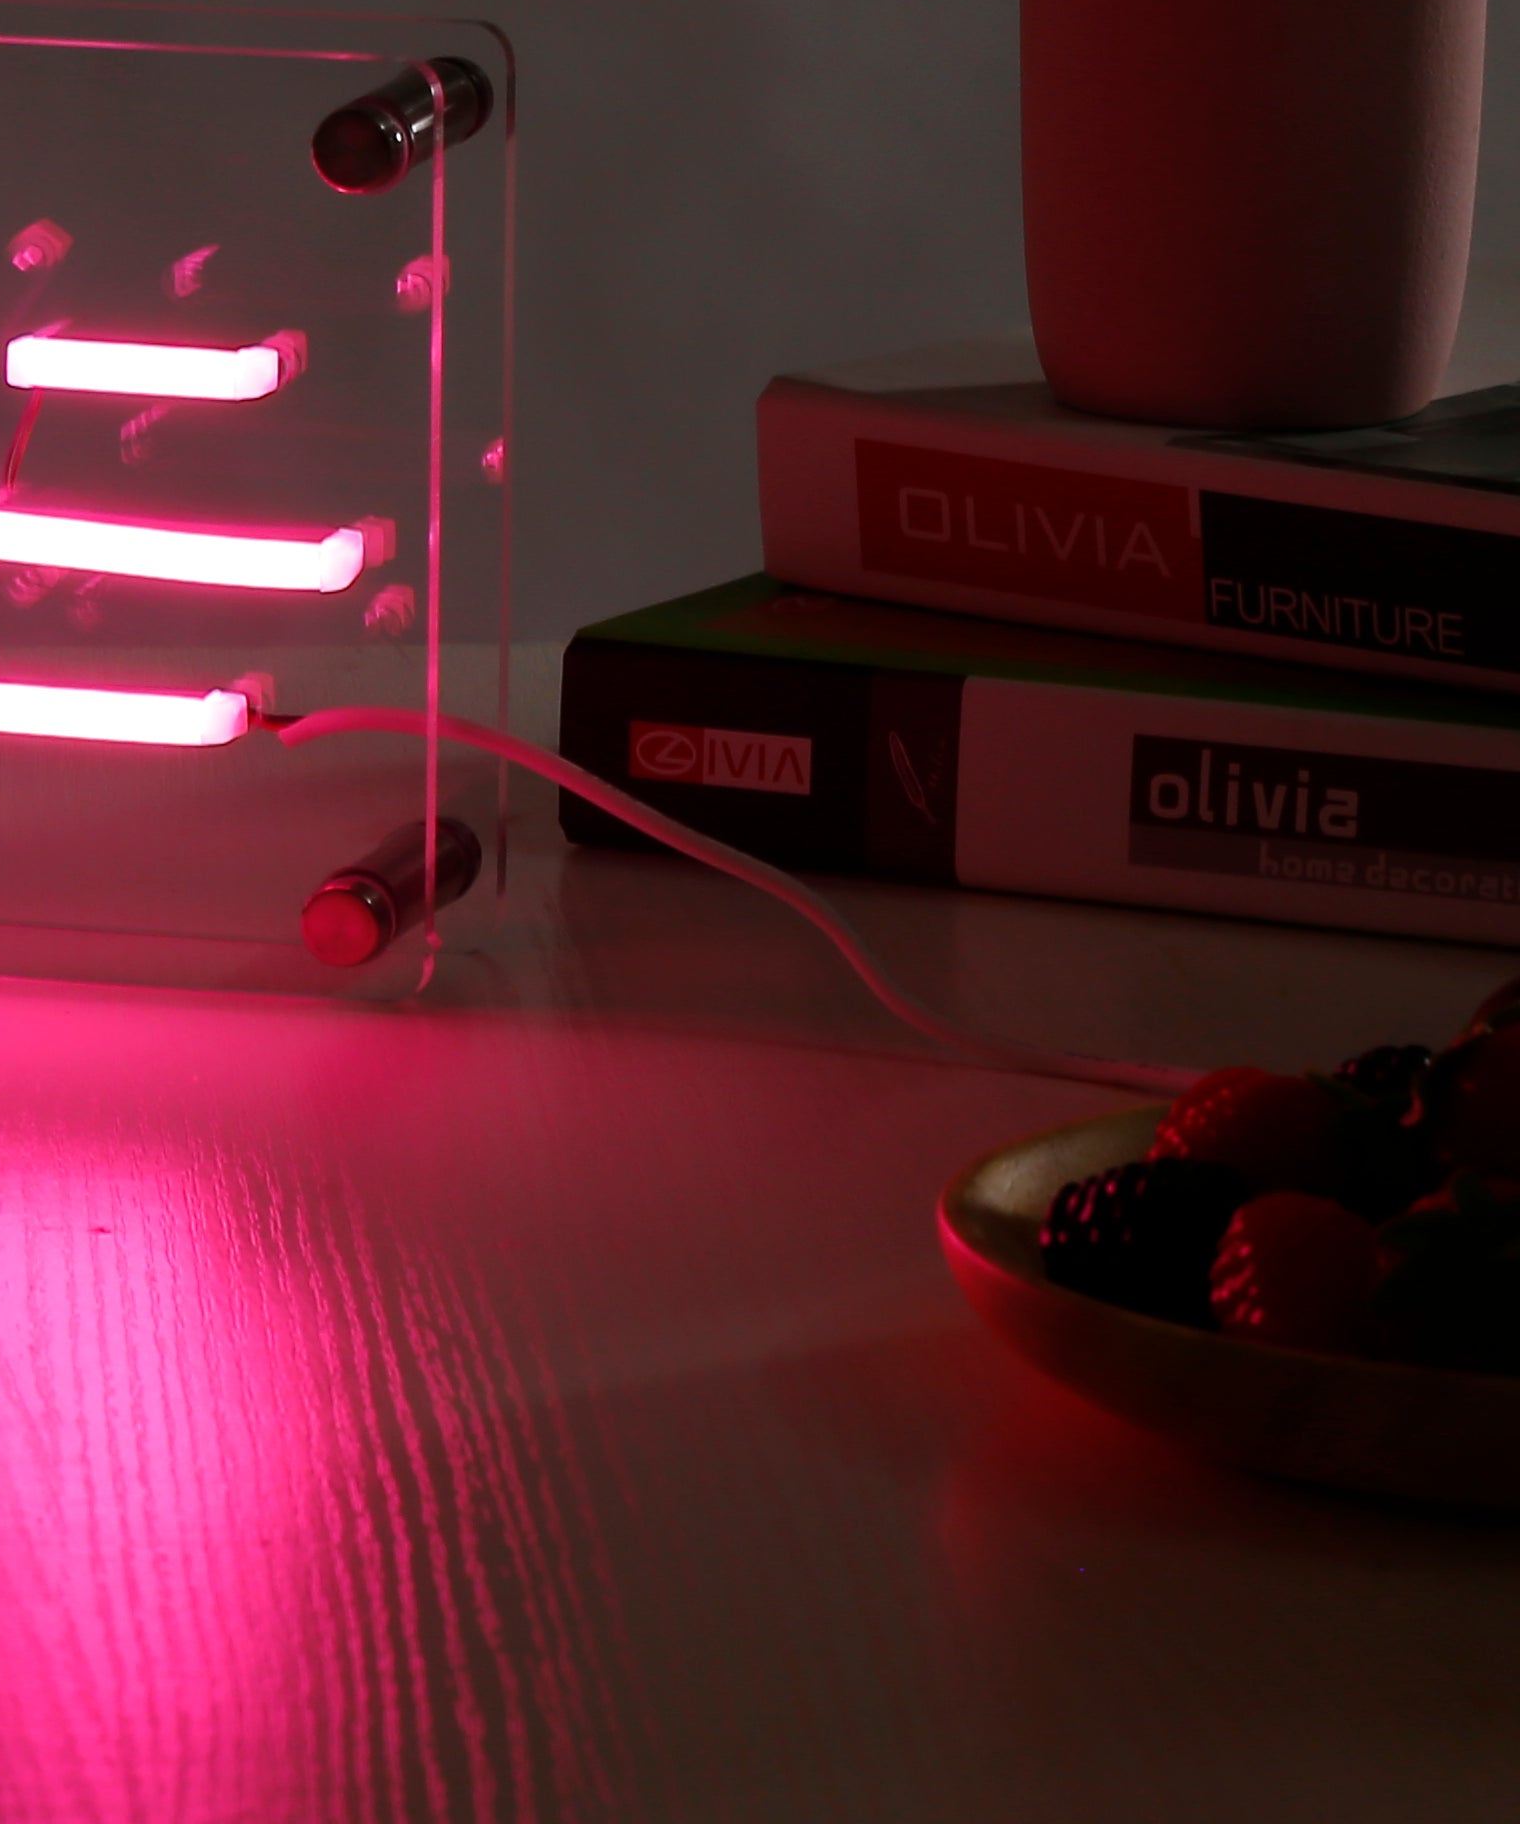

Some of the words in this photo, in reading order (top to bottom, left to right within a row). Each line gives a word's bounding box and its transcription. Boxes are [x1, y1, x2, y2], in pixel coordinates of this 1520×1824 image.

[898, 484, 1172, 579] OLIVIA
[1209, 577, 1465, 656] FURNITURE
[1148, 748, 1360, 840] olivia
[1258, 840, 1356, 884] home
